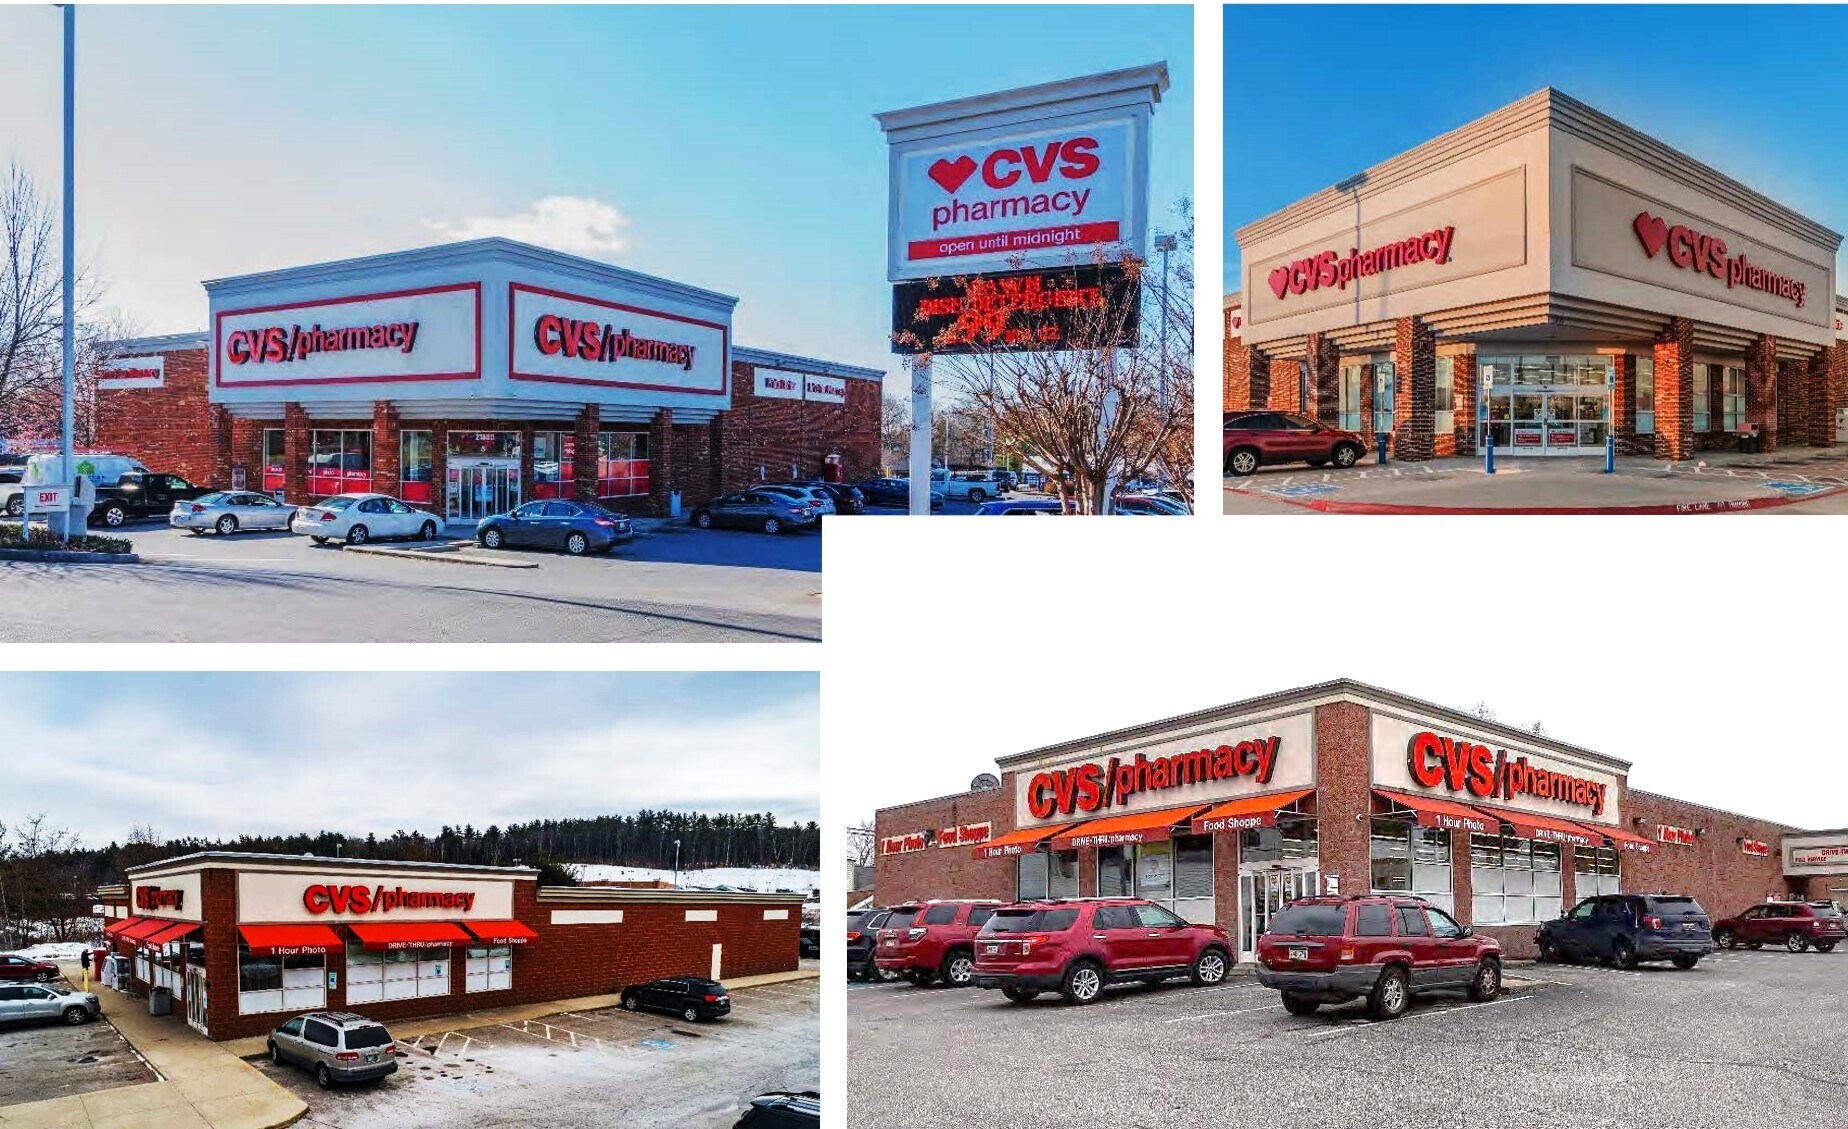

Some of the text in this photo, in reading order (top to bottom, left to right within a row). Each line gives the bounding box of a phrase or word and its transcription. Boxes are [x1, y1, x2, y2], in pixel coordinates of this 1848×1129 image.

[982, 137, 1100, 189] CVS
[933, 188, 1092, 231] pharmacy
[939, 228, 1080, 254] open until midnight
[39, 492, 58, 503] EXIT
[1204, 816, 1262, 831] Food Shoppe
[1435, 814, 1485, 831] 1 Hour Photo
[304, 884, 475, 914] CVS/pharmacy
[508, 937, 527, 945] Shoppe
[270, 945, 327, 955] 1 Hour Photo
